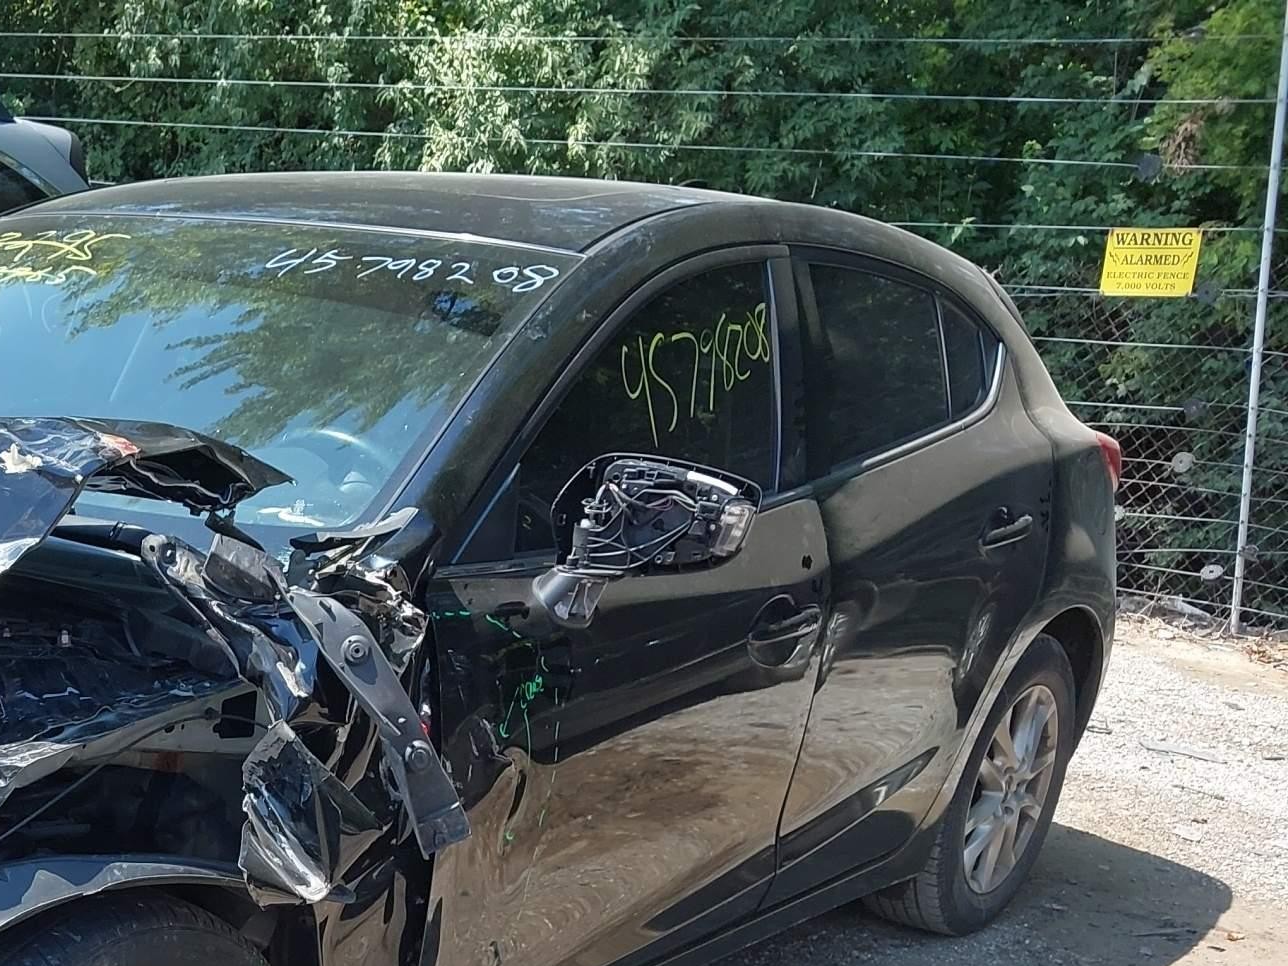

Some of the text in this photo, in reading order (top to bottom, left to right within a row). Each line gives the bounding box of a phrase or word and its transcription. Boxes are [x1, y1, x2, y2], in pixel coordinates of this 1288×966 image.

[1116, 231, 1194, 246] WARNING
[1120, 253, 1181, 266] ALARMED
[1106, 271, 1190, 280] ELECTRIC FENCE
[1115, 282, 1177, 291] 7,000 VOLTS
